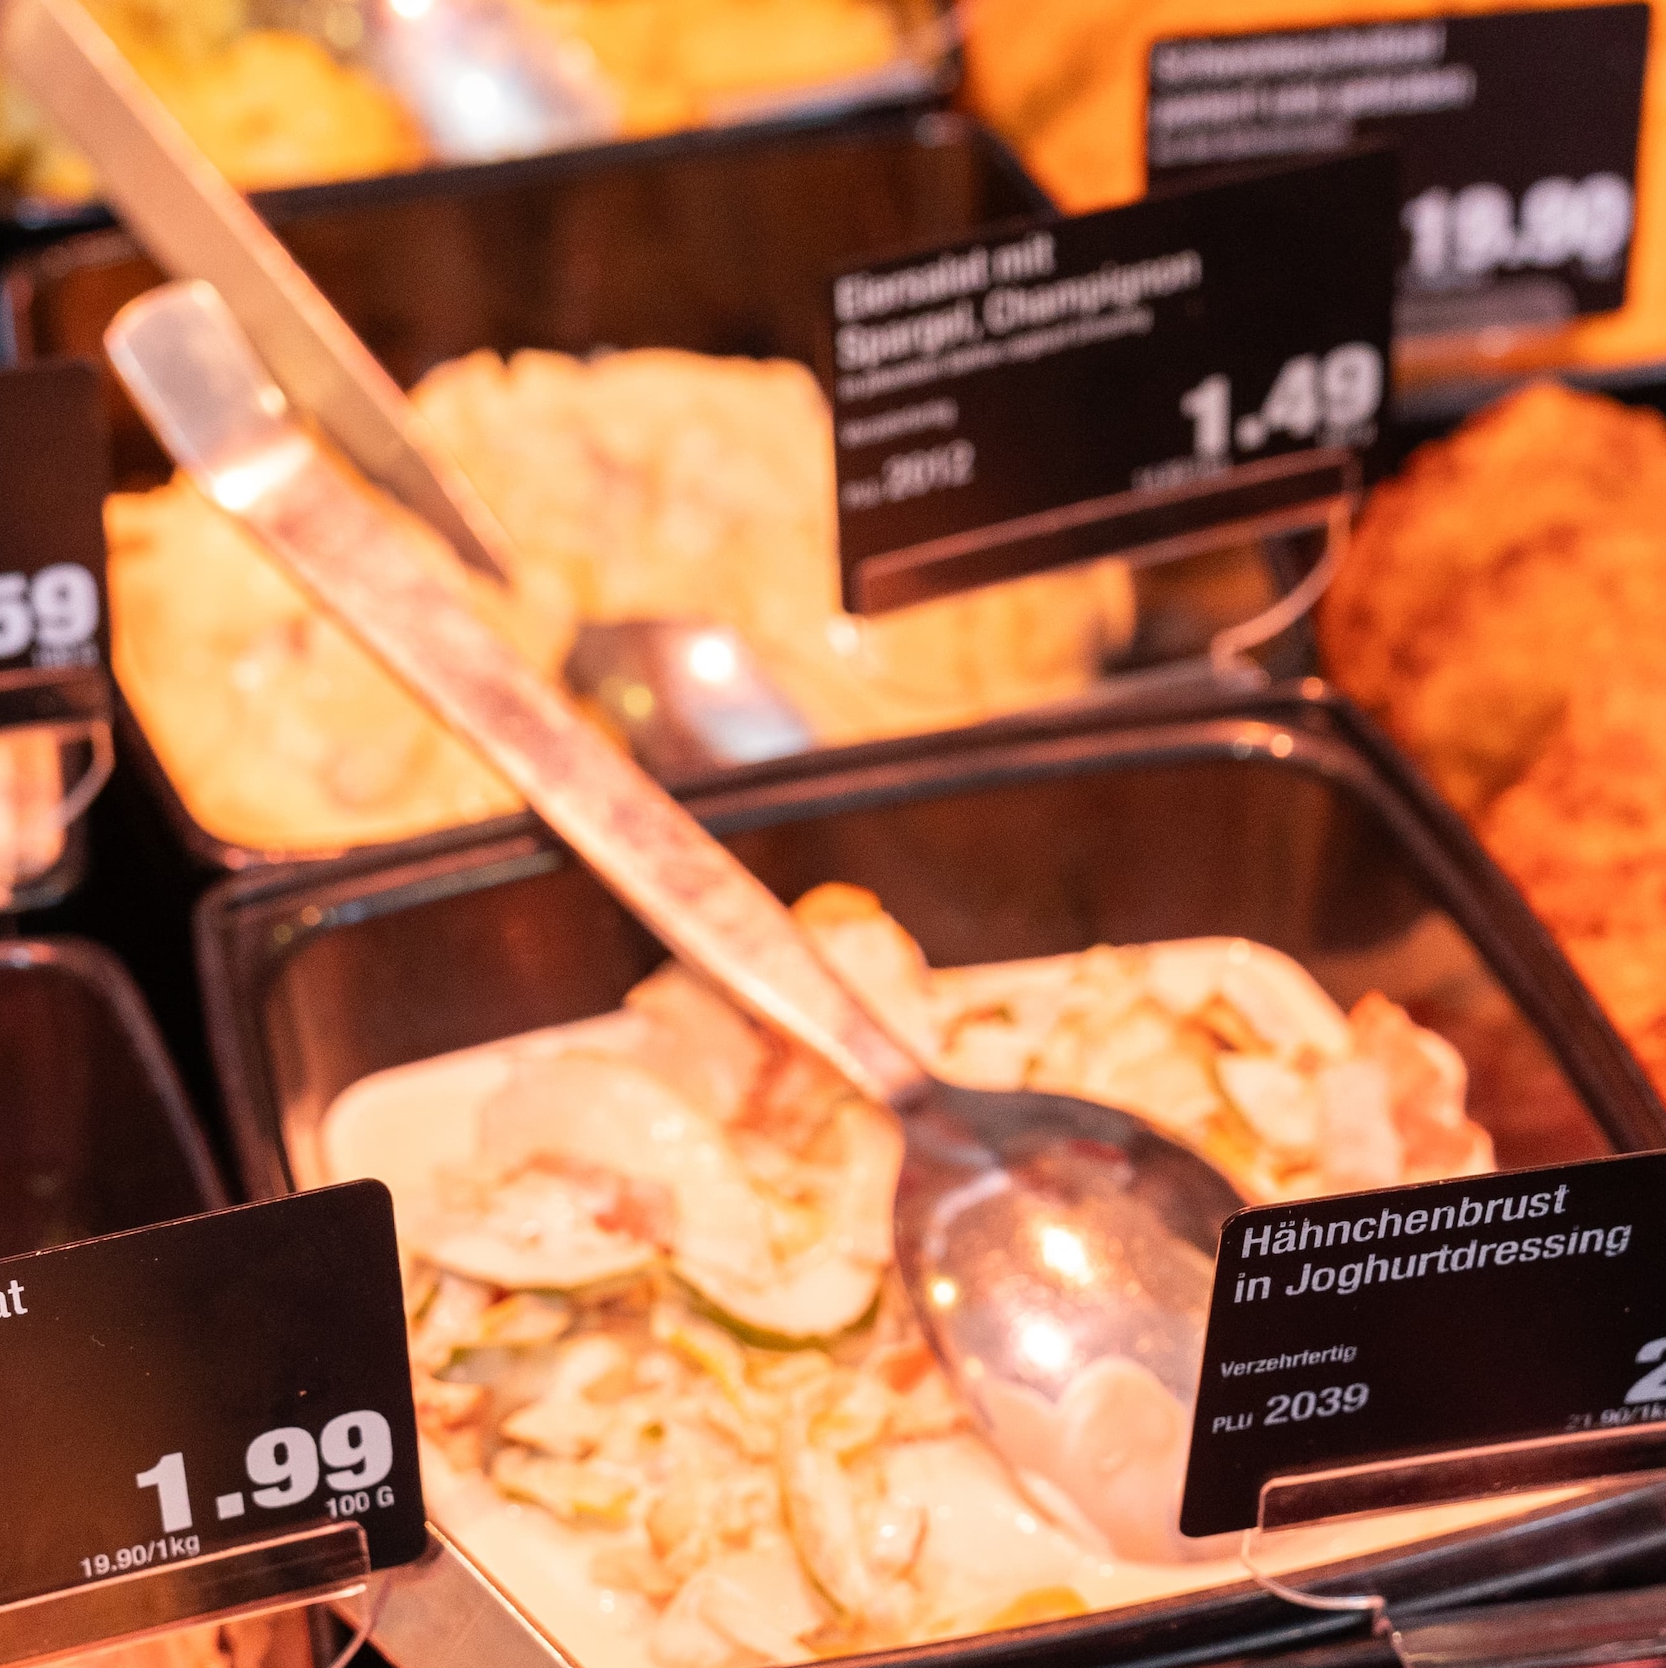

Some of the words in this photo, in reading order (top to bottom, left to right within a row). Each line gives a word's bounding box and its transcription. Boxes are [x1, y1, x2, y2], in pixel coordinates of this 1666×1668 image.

[1179, 340, 1384, 456] 1.49
[1241, 1183, 1570, 1258] Hähnchenbrust
[1233, 1272, 1272, 1303] in
[1285, 1223, 1633, 1297] Joghurtdressing
[1221, 1343, 1358, 1379] Verzehrfertig
[1212, 1412, 1253, 1434] PLU
[1263, 1382, 1370, 1427] 2039
[136, 1409, 393, 1533] 1.99
[324, 1490, 370, 1519] 100
[375, 1486, 395, 1508] G
[80, 1534, 201, 1579] 19.90/1kg
